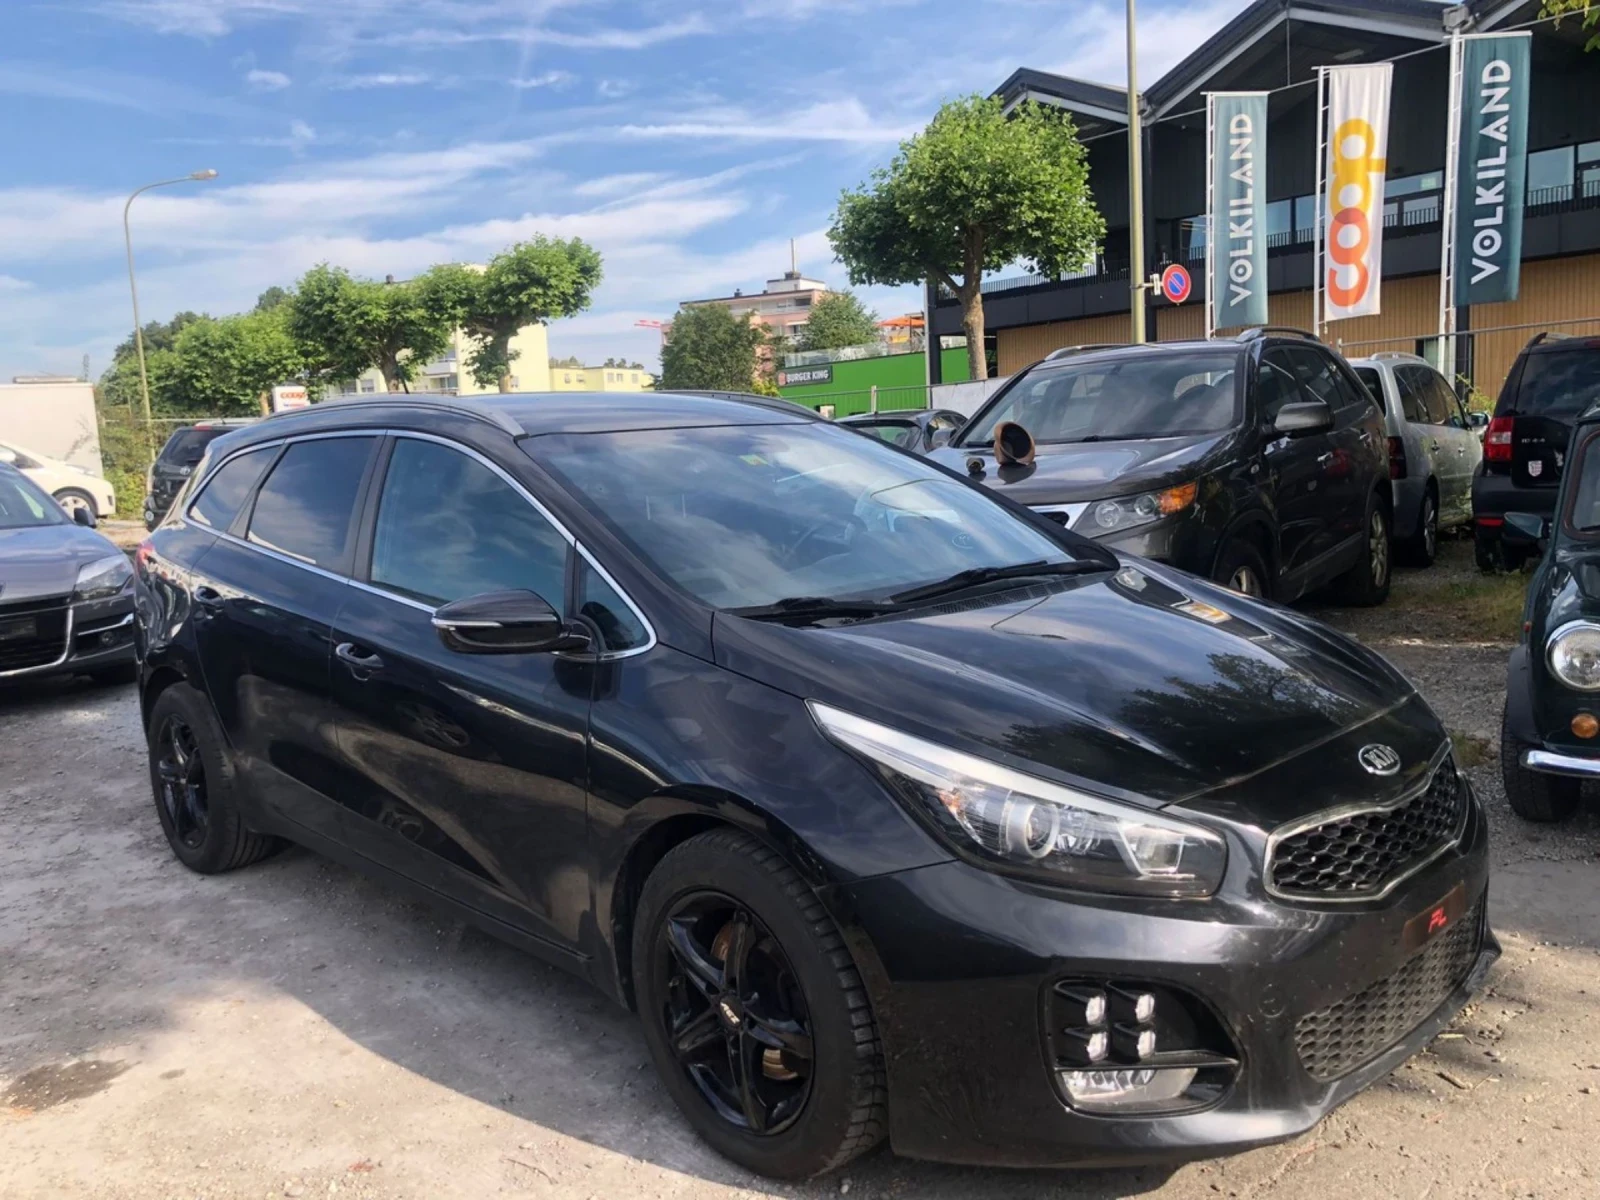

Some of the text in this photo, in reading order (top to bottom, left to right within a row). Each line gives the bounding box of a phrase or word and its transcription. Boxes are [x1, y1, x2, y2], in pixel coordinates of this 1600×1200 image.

[1229, 113, 1253, 307] VOLKILAND
[1328, 117, 1388, 307] coop
[1470, 59, 1512, 285] VOLKILAND
[786, 369, 829, 383] BURGER KING
